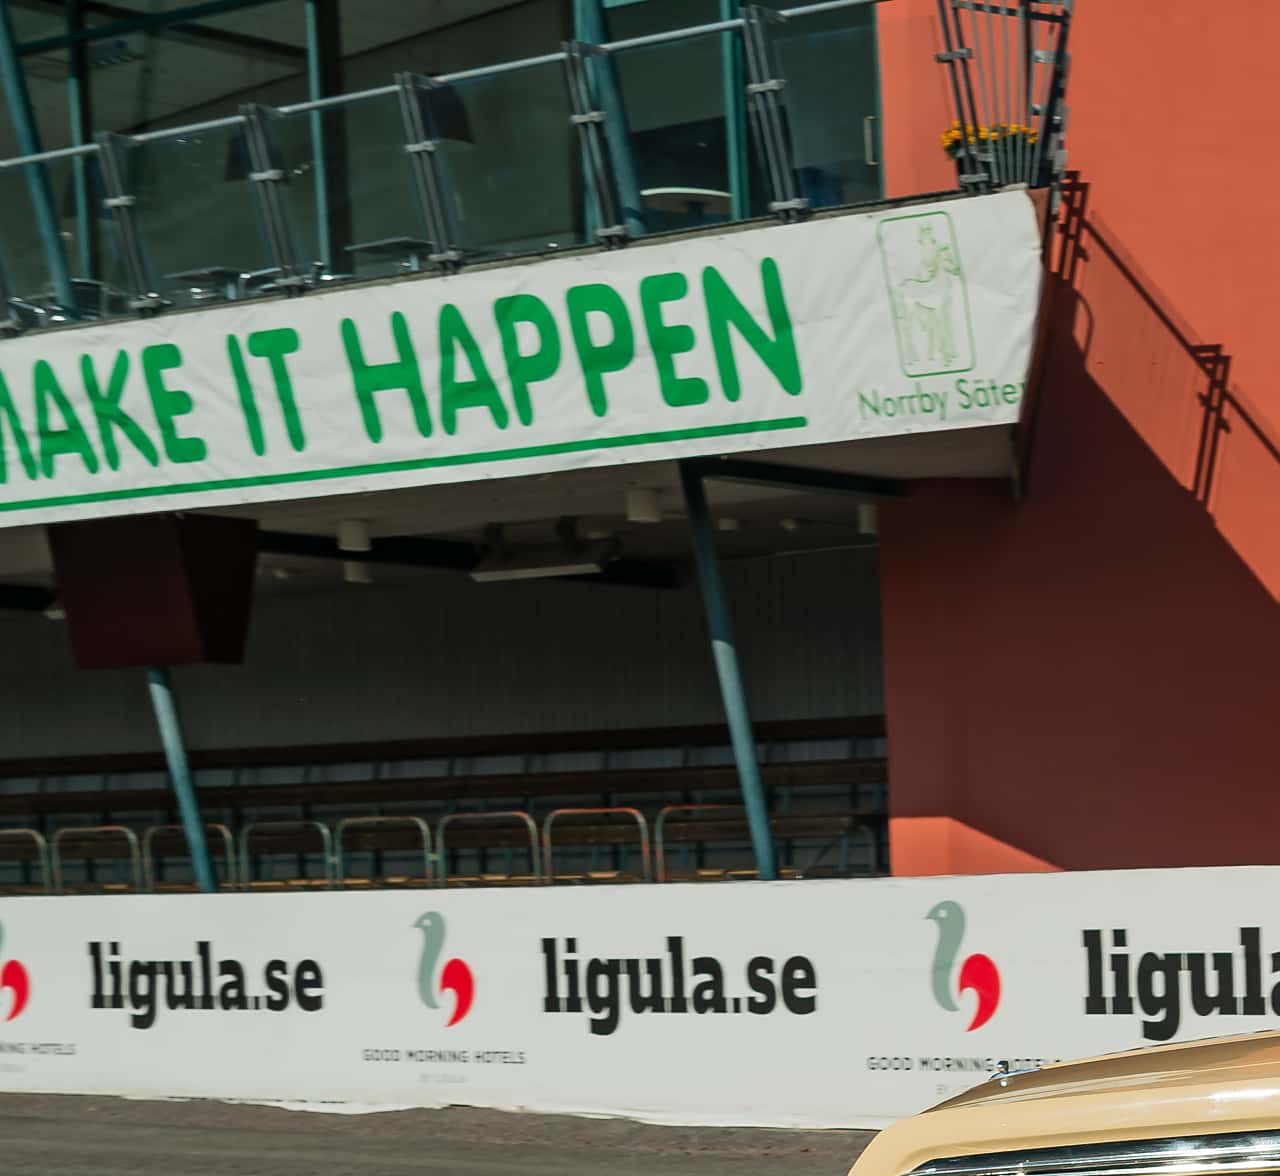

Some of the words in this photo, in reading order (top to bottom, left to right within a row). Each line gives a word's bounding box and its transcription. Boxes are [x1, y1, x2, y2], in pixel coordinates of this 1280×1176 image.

[227, 328, 306, 457] IT
[340, 257, 804, 444] HAPPEN
[857, 382, 949, 421] Norrby
[88, 941, 324, 1030] ligula.se
[541, 936, 817, 1036] ligula.se
[363, 1049, 400, 1062] GOOD
[406, 1049, 470, 1063] MORNING
[474, 1050, 526, 1064] HOTELS
[868, 1056, 912, 1071] GOOD
[919, 1056, 993, 1072] MORNING
